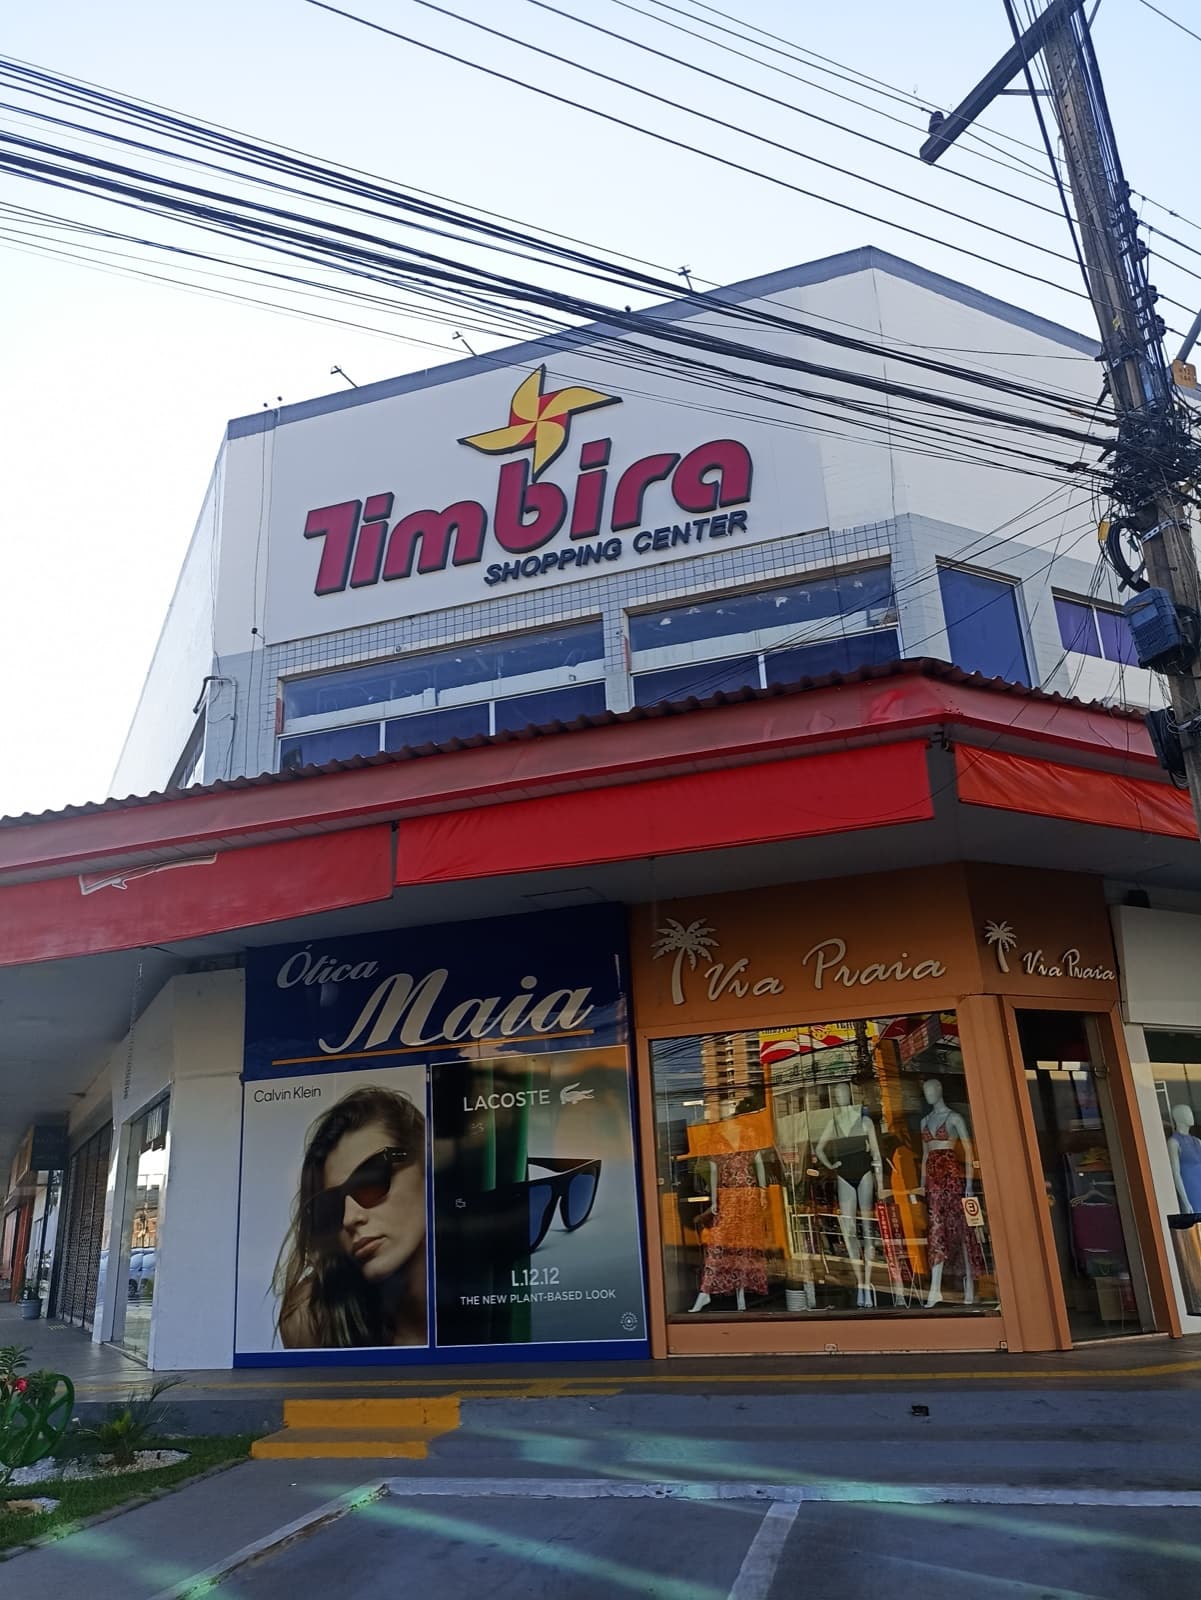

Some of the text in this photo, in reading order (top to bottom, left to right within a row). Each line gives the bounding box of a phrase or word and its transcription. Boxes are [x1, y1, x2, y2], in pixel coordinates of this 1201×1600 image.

[303, 438, 754, 596] Timbira
[483, 509, 749, 587] SHOPPING CENTER
[276, 944, 380, 990] Ótica
[703, 937, 947, 1001] Via Praia
[1023, 949, 1115, 980] Via Praia
[319, 969, 594, 1053] Maia
[254, 1087, 321, 1103] Calvin Klein
[463, 1089, 551, 1112] LACOSTE
[511, 1268, 560, 1287] L.12.12
[460, 1288, 616, 1306] THE NEW PLANT-BASED LOOK
